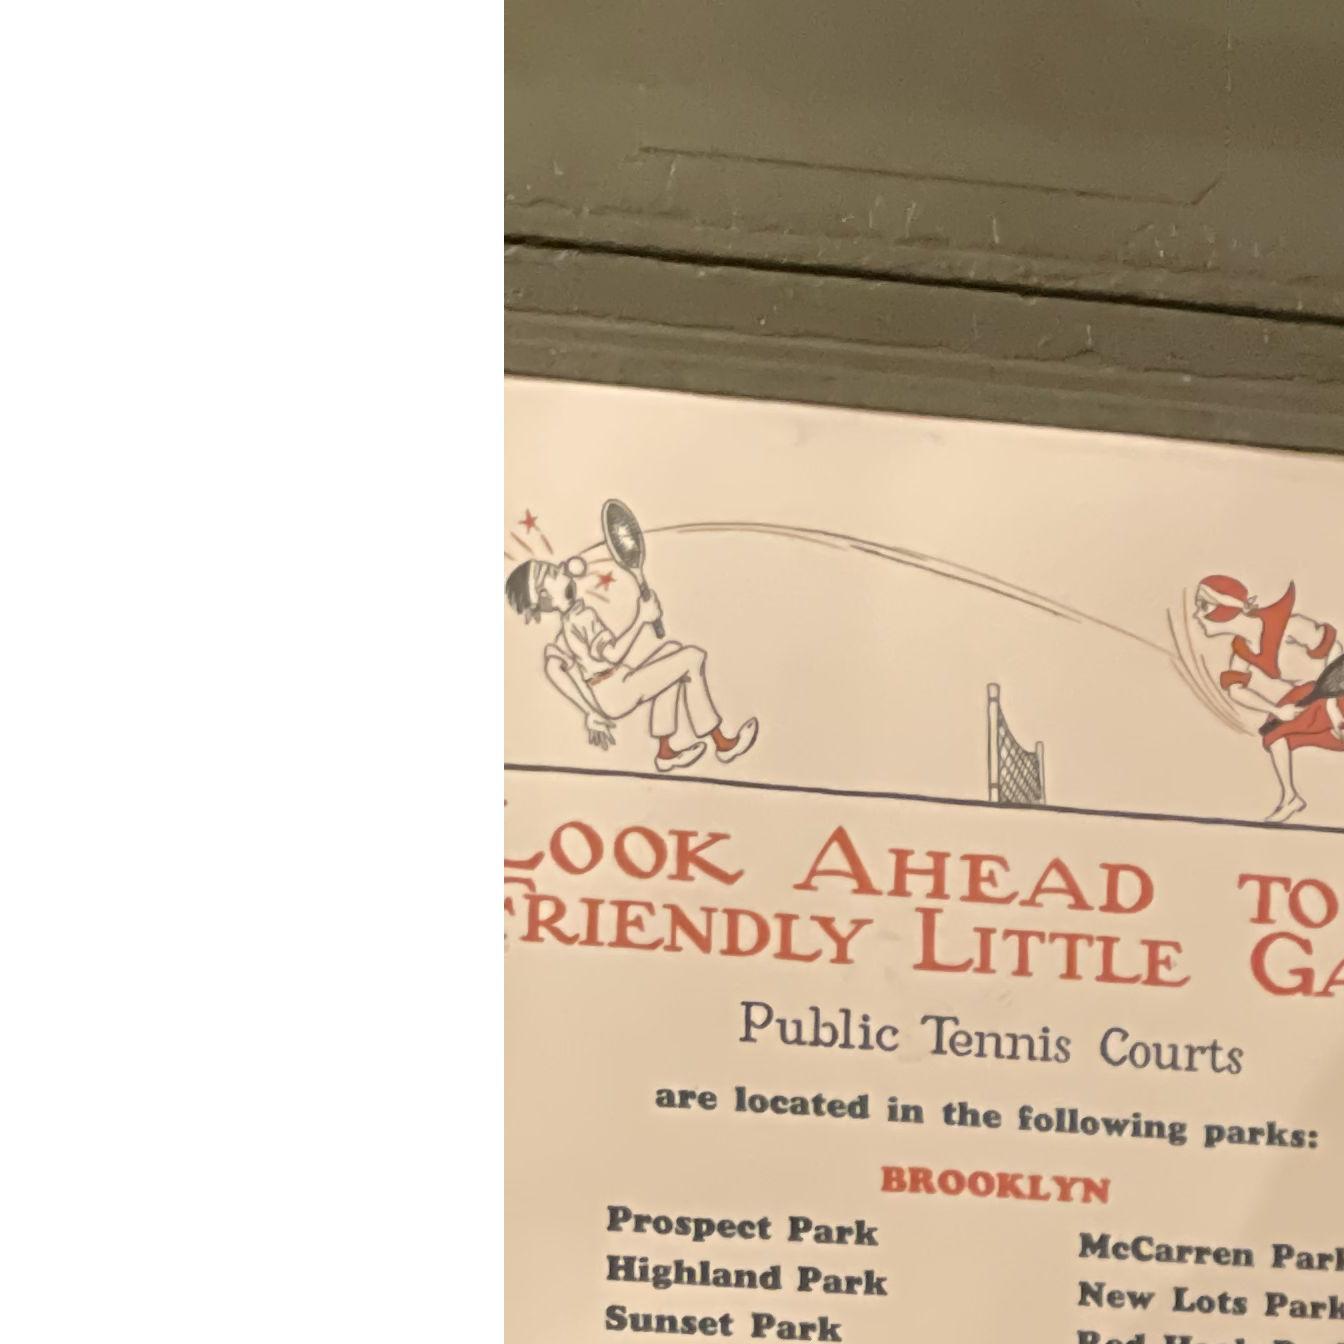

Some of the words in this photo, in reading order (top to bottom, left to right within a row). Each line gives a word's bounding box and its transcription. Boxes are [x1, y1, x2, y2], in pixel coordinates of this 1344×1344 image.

[792, 825, 1155, 915] AHEAD
[1237, 873, 1339, 930] TO
[503, 876, 874, 964] RIENDLY
[912, 906, 1191, 988] LITTLE
[738, 1000, 901, 1053] Public
[919, 1014, 1072, 1064] Tennis
[1098, 1026, 1245, 1076] Courts
[654, 1087, 718, 1111] are
[733, 1085, 871, 1120] located
[886, 1095, 925, 1125] in
[941, 1100, 1002, 1129] the
[1017, 1104, 1188, 1147] following
[1203, 1120, 1319, 1150] parks:
[880, 1165, 1111, 1204] BROOKLYN
[605, 1204, 773, 1246] Prospect
[785, 1214, 880, 1247] Park
[1078, 1231, 1255, 1268] McCarren
[605, 1254, 783, 1292] Highland
[796, 1265, 889, 1297] Park
[1076, 1280, 1157, 1311] New
[1171, 1285, 1249, 1317] Lots
[603, 1303, 736, 1338] Sunset
[749, 1311, 844, 1344] Park
